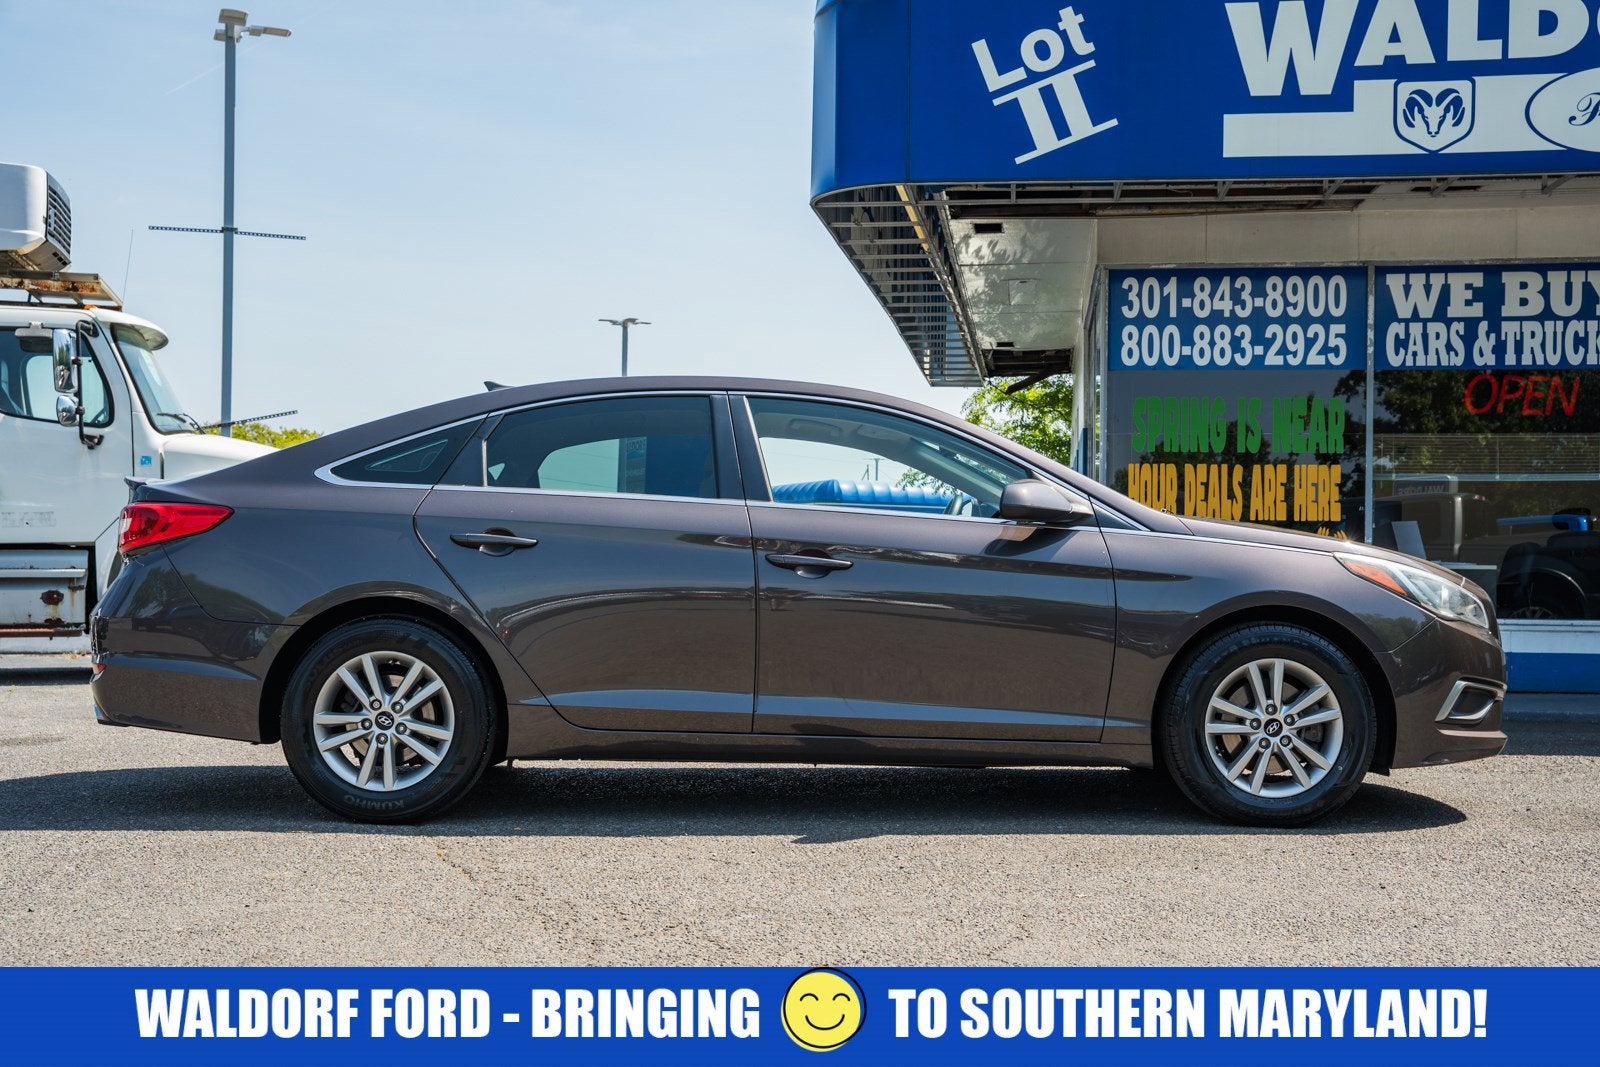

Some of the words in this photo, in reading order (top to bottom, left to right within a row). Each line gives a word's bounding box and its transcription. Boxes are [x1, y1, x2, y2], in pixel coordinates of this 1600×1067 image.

[971, 5, 1096, 93] Lot
[1224, 0, 1600, 96] WALD
[992, 59, 1119, 165] II
[1121, 275, 1348, 318] 301-843-8900
[1386, 272, 1484, 319] WE
[1121, 324, 1348, 366] 800-883-2925
[1385, 321, 1466, 367] CARS
[1472, 320, 1496, 366] &
[1464, 374, 1580, 416] OPEN
[1132, 396, 1227, 454] SPRING
[1236, 396, 1262, 454] IS
[1272, 397, 1346, 454] NEAR
[1184, 463, 1244, 521] DEALS
[1250, 464, 1288, 521] ARE
[1294, 464, 1342, 521] HERE
